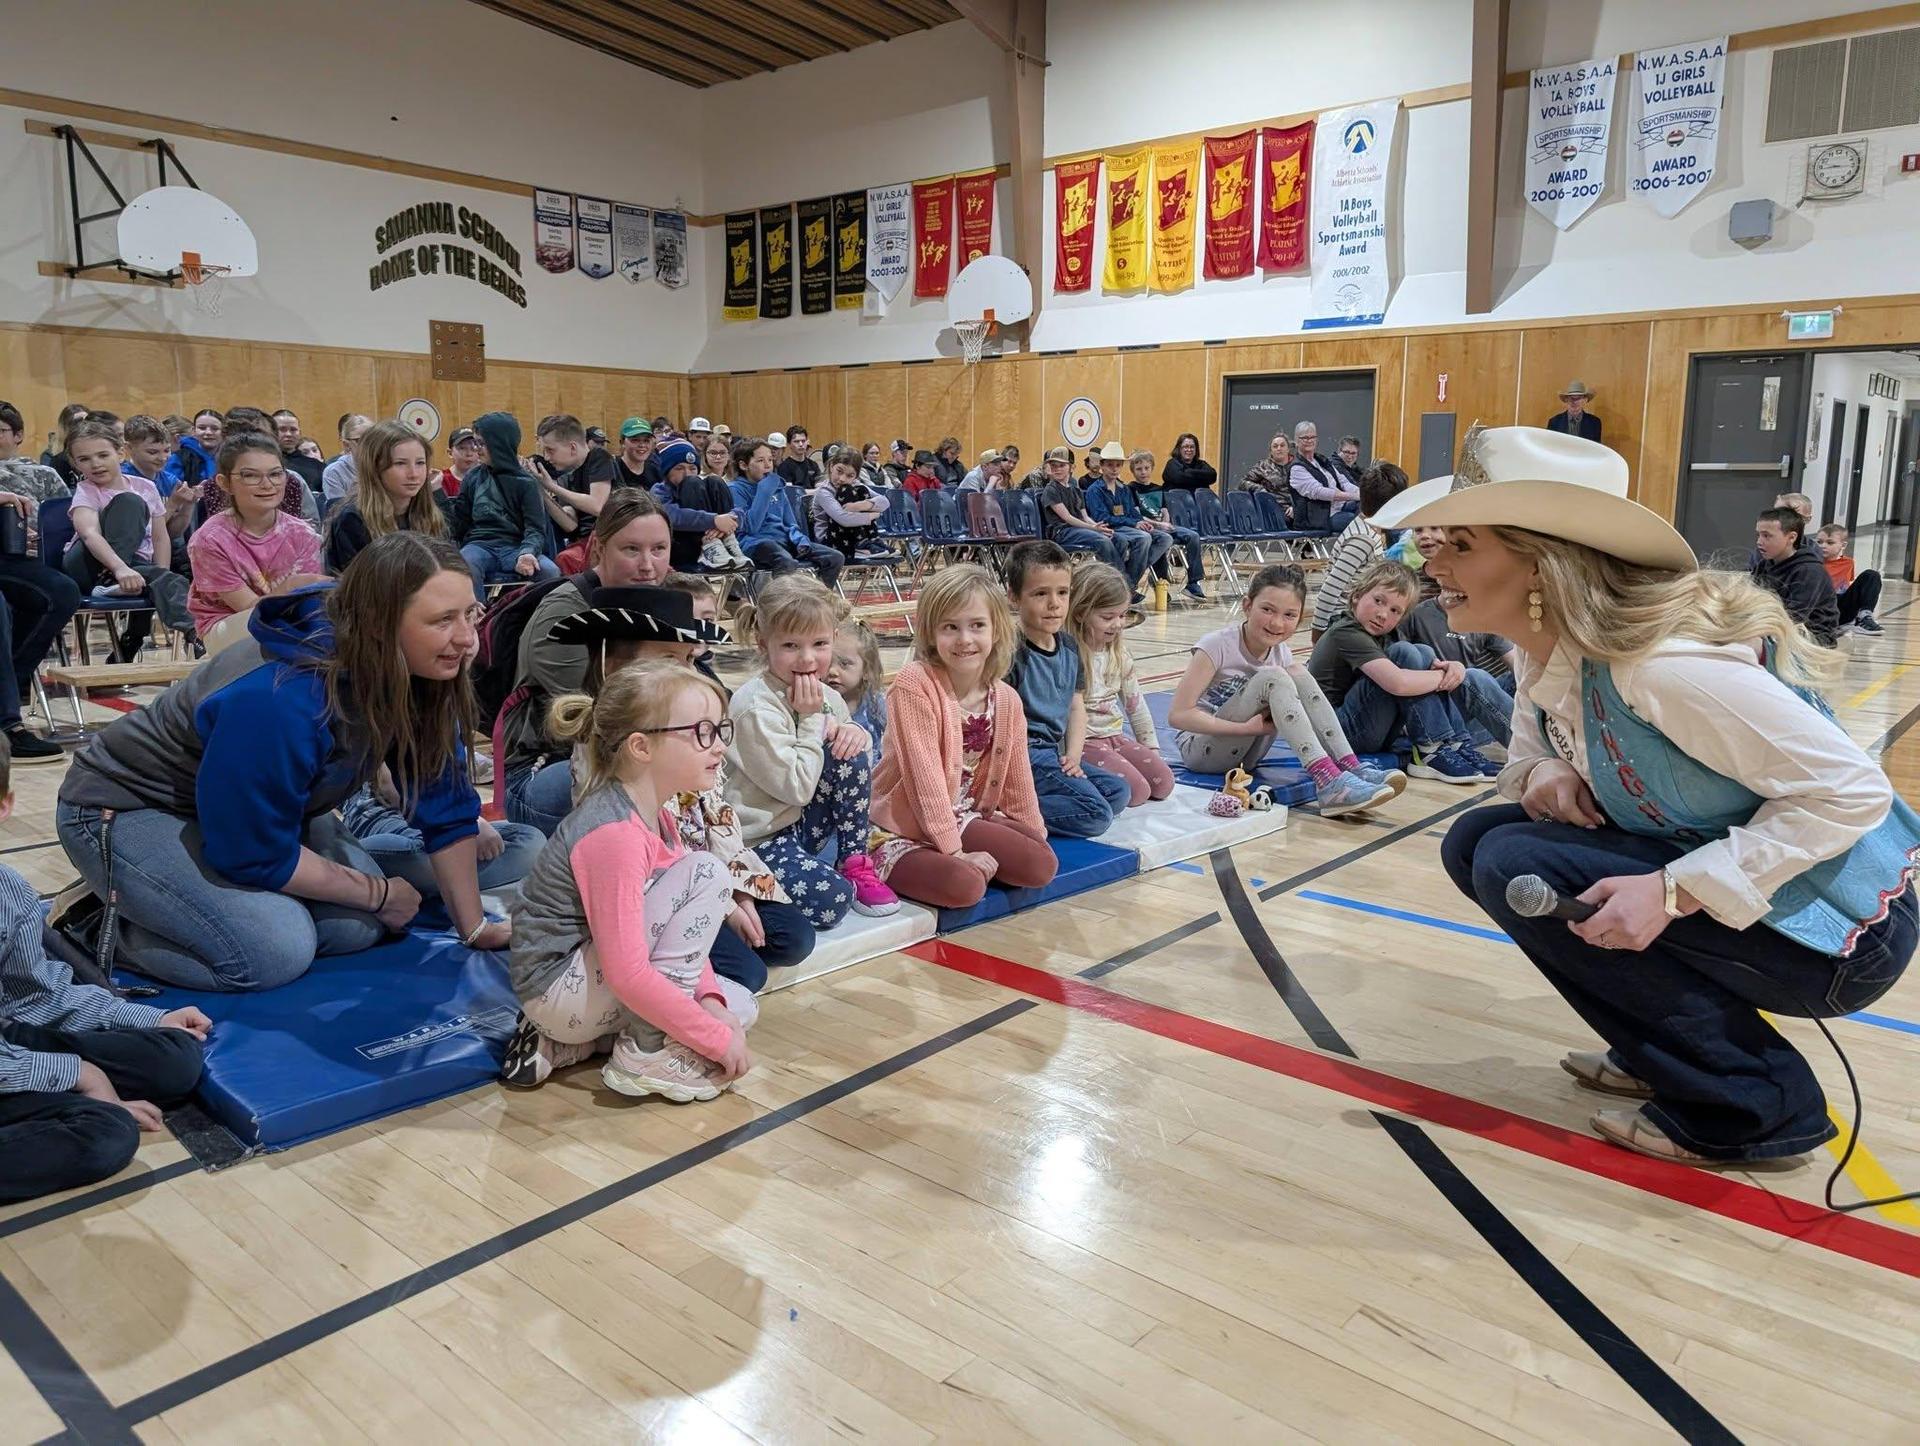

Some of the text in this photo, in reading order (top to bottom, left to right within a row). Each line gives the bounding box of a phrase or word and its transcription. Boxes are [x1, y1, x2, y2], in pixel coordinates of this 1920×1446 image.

[1637, 45, 1726, 72] N.W.A.S.A.A.
[1671, 66, 1705, 82] GIRLS
[1568, 84, 1596, 100] BOYS
[1644, 81, 1715, 104] VOLLEYBALL
[1541, 98, 1606, 119] VOLLEYBALL
[1643, 109, 1712, 129] SPORTSMANSHIP
[1539, 126, 1602, 144] SPORTSMANSHIP
[1652, 155, 1696, 173] AWARD
[1547, 168, 1588, 184] AWARD
[886, 201, 901, 211] GIRLS
[1351, 198, 1372, 211] Boys
[875, 212, 906, 223] VOLLEYBALL
[1332, 209, 1377, 228] Volleyball
[375, 201, 523, 278] SAVANNA SCHOOL
[1339, 241, 1367, 256] Award
[881, 255, 900, 265] AWARD
[369, 243, 528, 309] HOME OF THE BEARS
